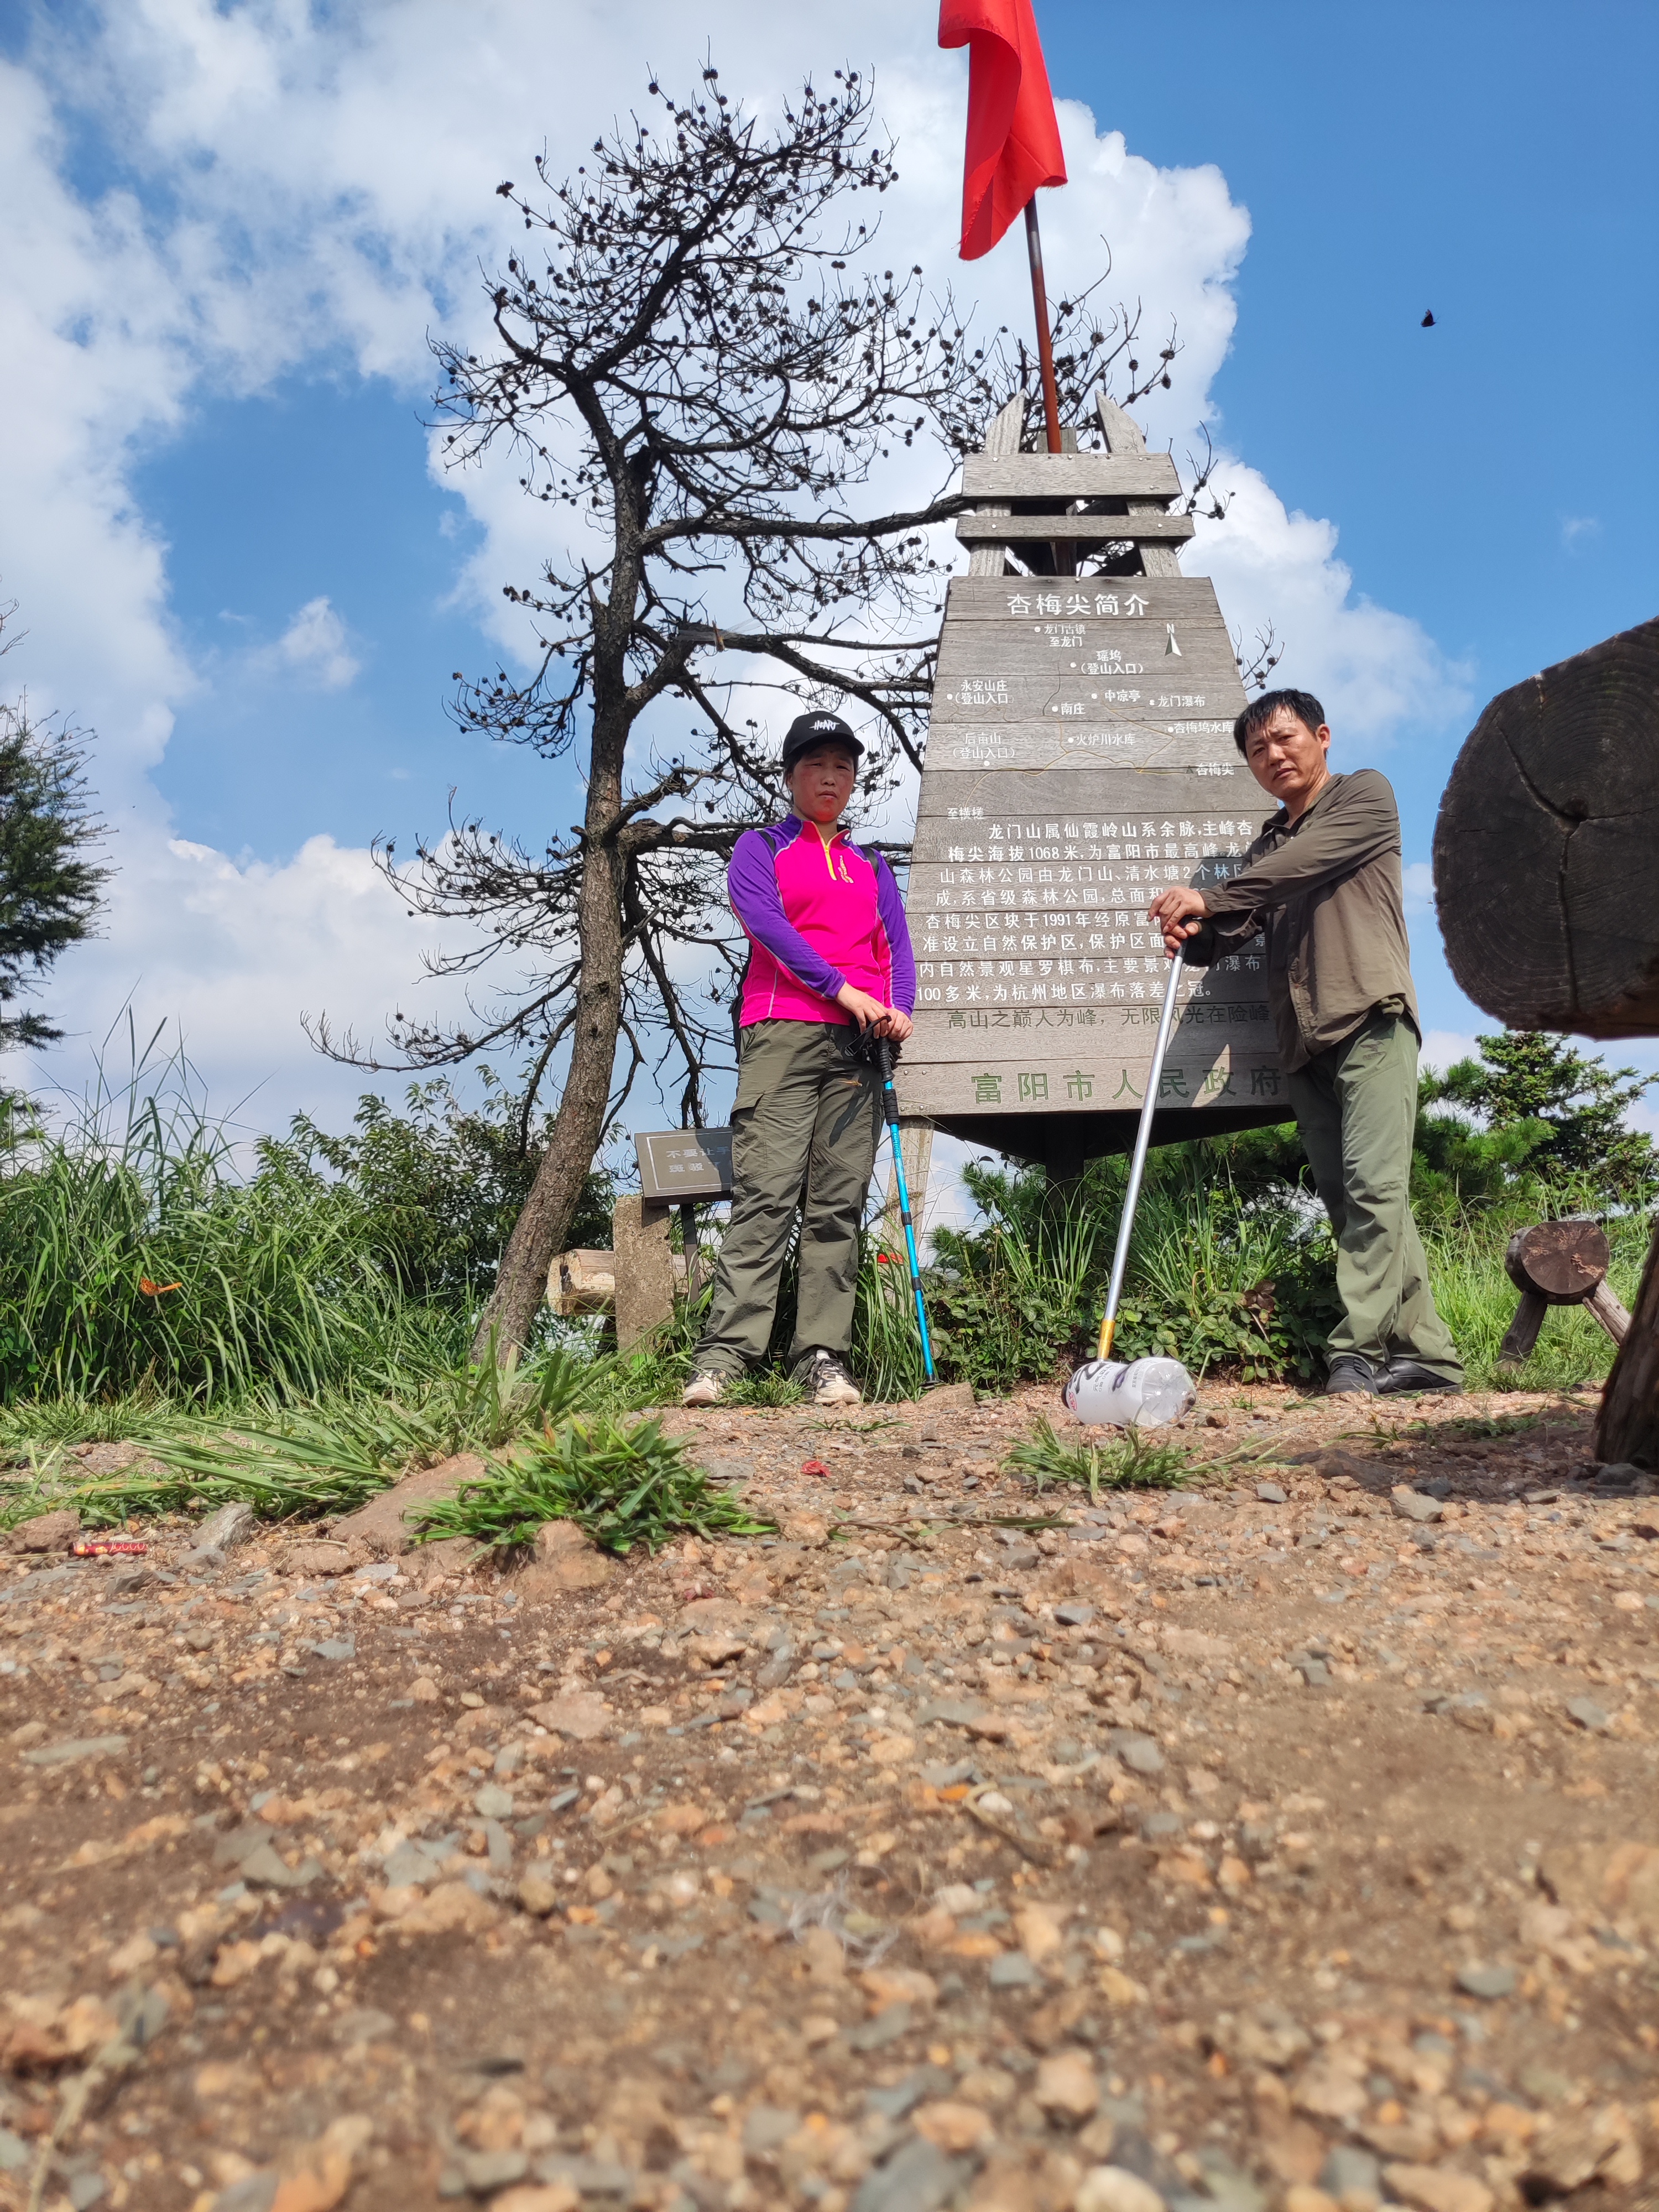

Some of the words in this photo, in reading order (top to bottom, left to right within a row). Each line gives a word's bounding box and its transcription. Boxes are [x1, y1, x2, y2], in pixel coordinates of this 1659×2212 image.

[1006, 593, 1149, 616] 杏梅尖简介
[1044, 624, 1086, 635] 龙门古镇
[1166, 623, 1175, 634] N
[1049, 636, 1083, 648] 至龙门
[1096, 650, 1122, 662] 瑶坞
[961, 679, 1008, 692] 永安山庄
[1104, 689, 1141, 702] 中凉亭
[1157, 695, 1206, 708] 龙门瀑布
[1061, 702, 1086, 715] 南庄
[1174, 722, 1234, 734] 杏梅坞水库
[965, 732, 1001, 745] 后亩山
[1077, 733, 1136, 747] 火炉川水库
[1196, 763, 1234, 776] 杏梅尖
[971, 1065, 1281, 1104] 富阳市人民政府
[666, 1146, 731, 1159] 不要让手
